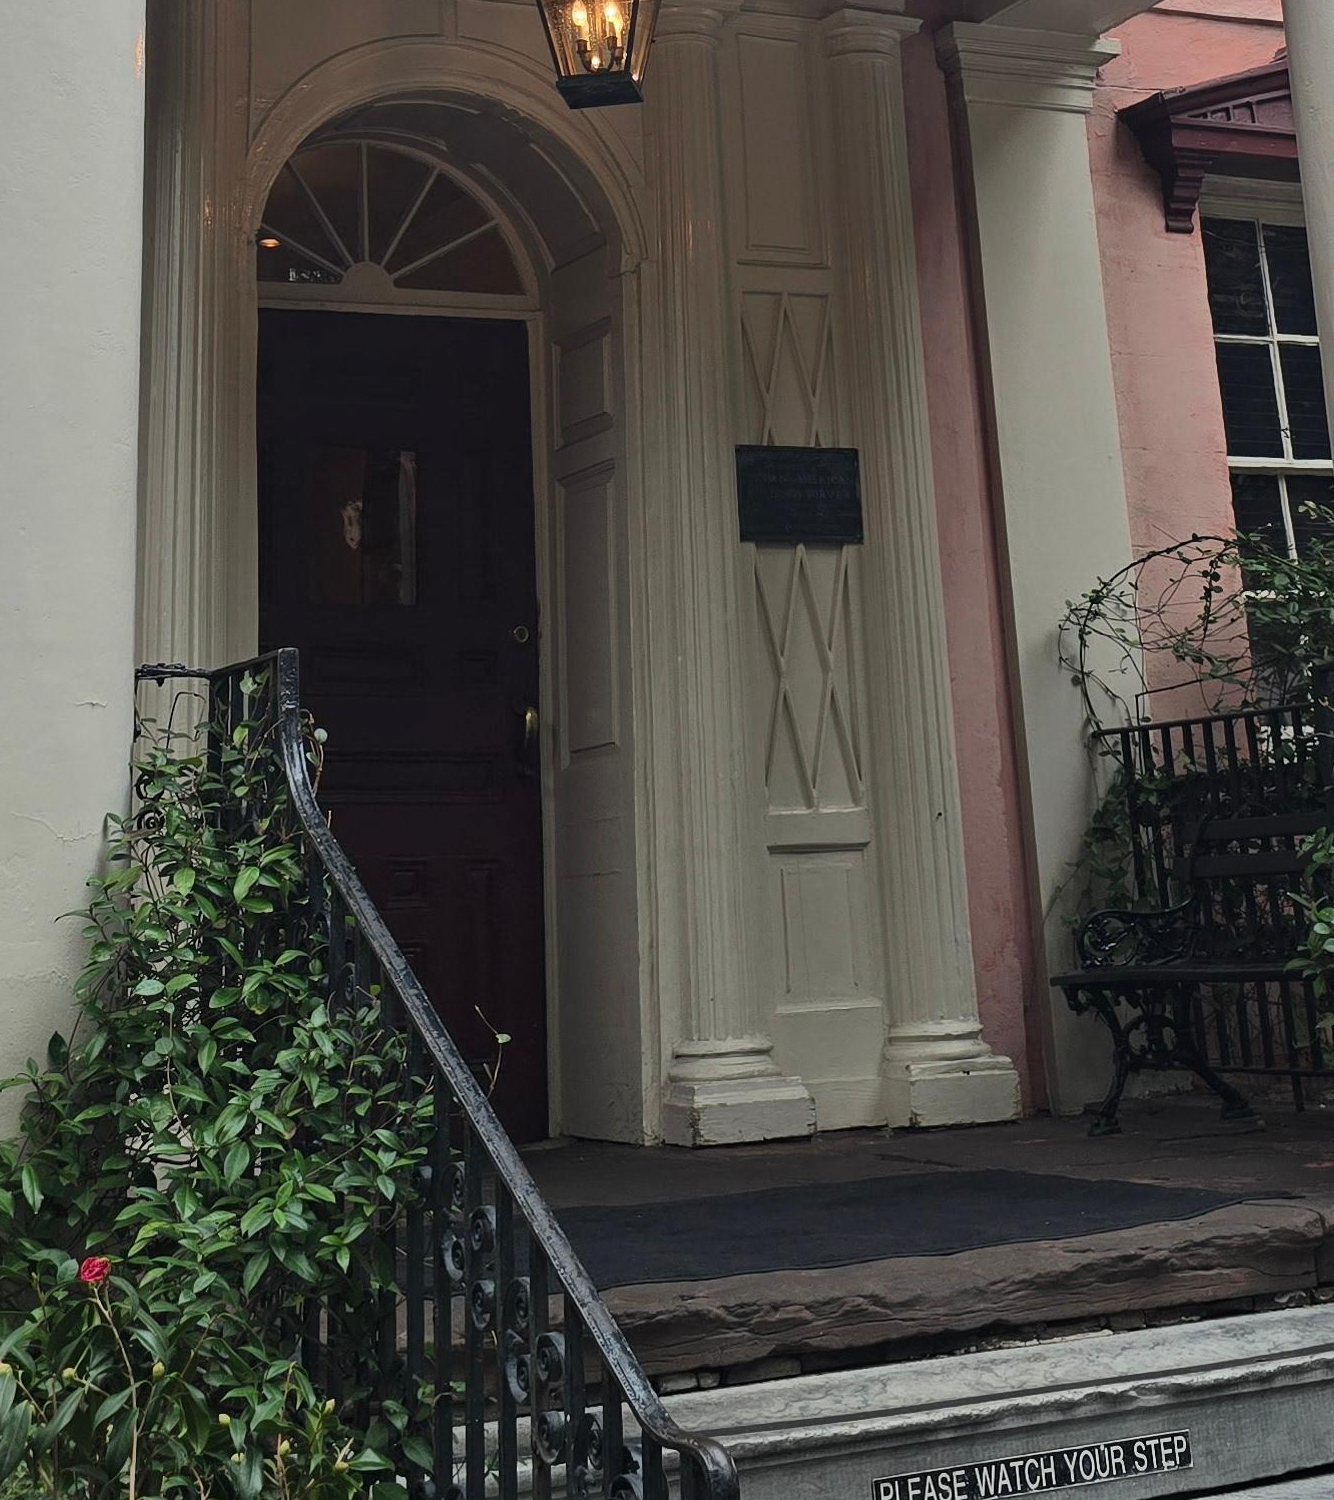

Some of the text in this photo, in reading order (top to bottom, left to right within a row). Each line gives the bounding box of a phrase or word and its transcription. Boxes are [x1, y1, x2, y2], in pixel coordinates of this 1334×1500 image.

[975, 1456, 1057, 1497] WATCH
[1064, 1445, 1127, 1482] YOUR
[1133, 1435, 1187, 1471] STEP
